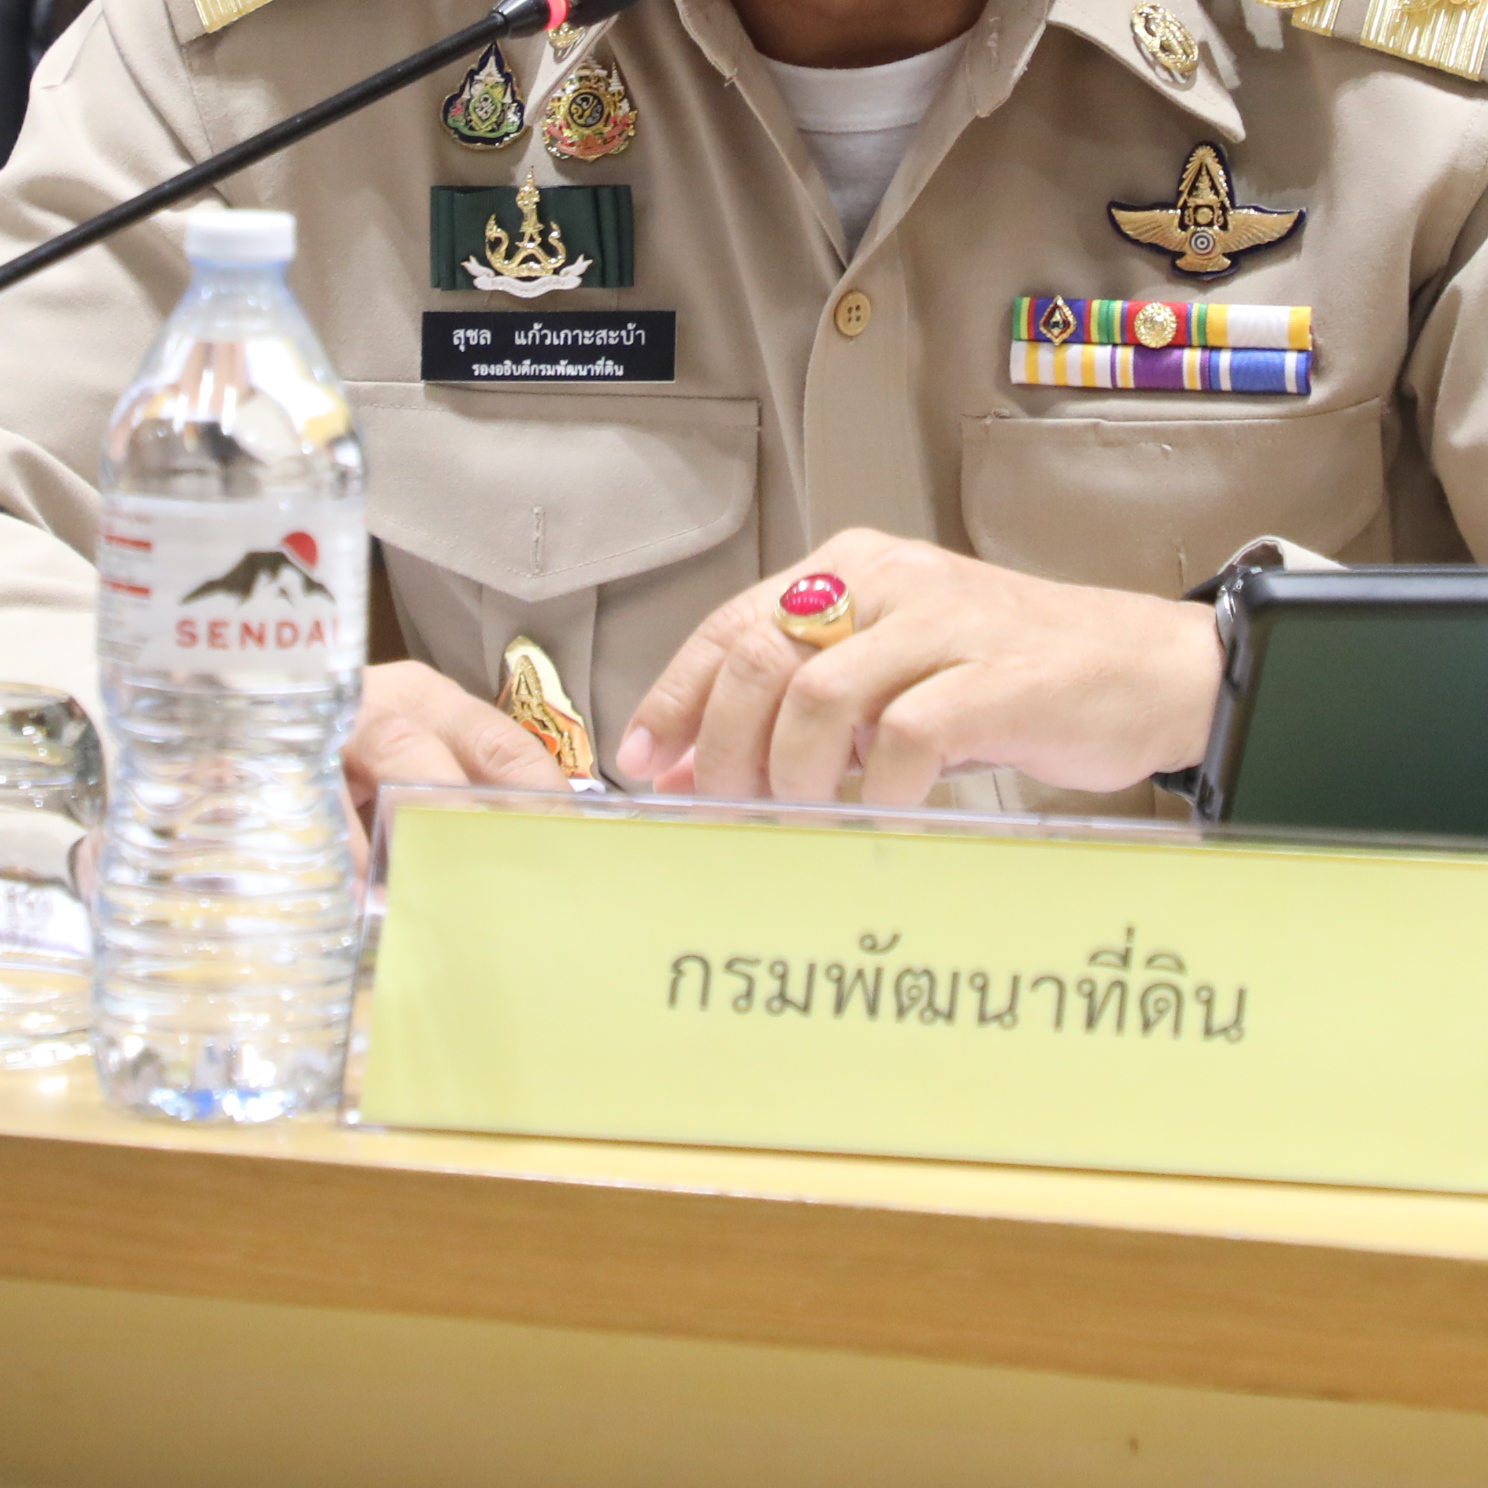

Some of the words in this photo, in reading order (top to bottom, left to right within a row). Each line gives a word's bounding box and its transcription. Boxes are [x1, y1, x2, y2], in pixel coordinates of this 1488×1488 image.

[452, 327, 492, 352] สุชล
[514, 322, 646, 346] แก้วเกาะสะบ้า
[471, 356, 624, 377] รองอธิบดีกรมพัฒนาที่ดิน
[667, 926, 1249, 1045] กรมพัฒนาที่ดิน
